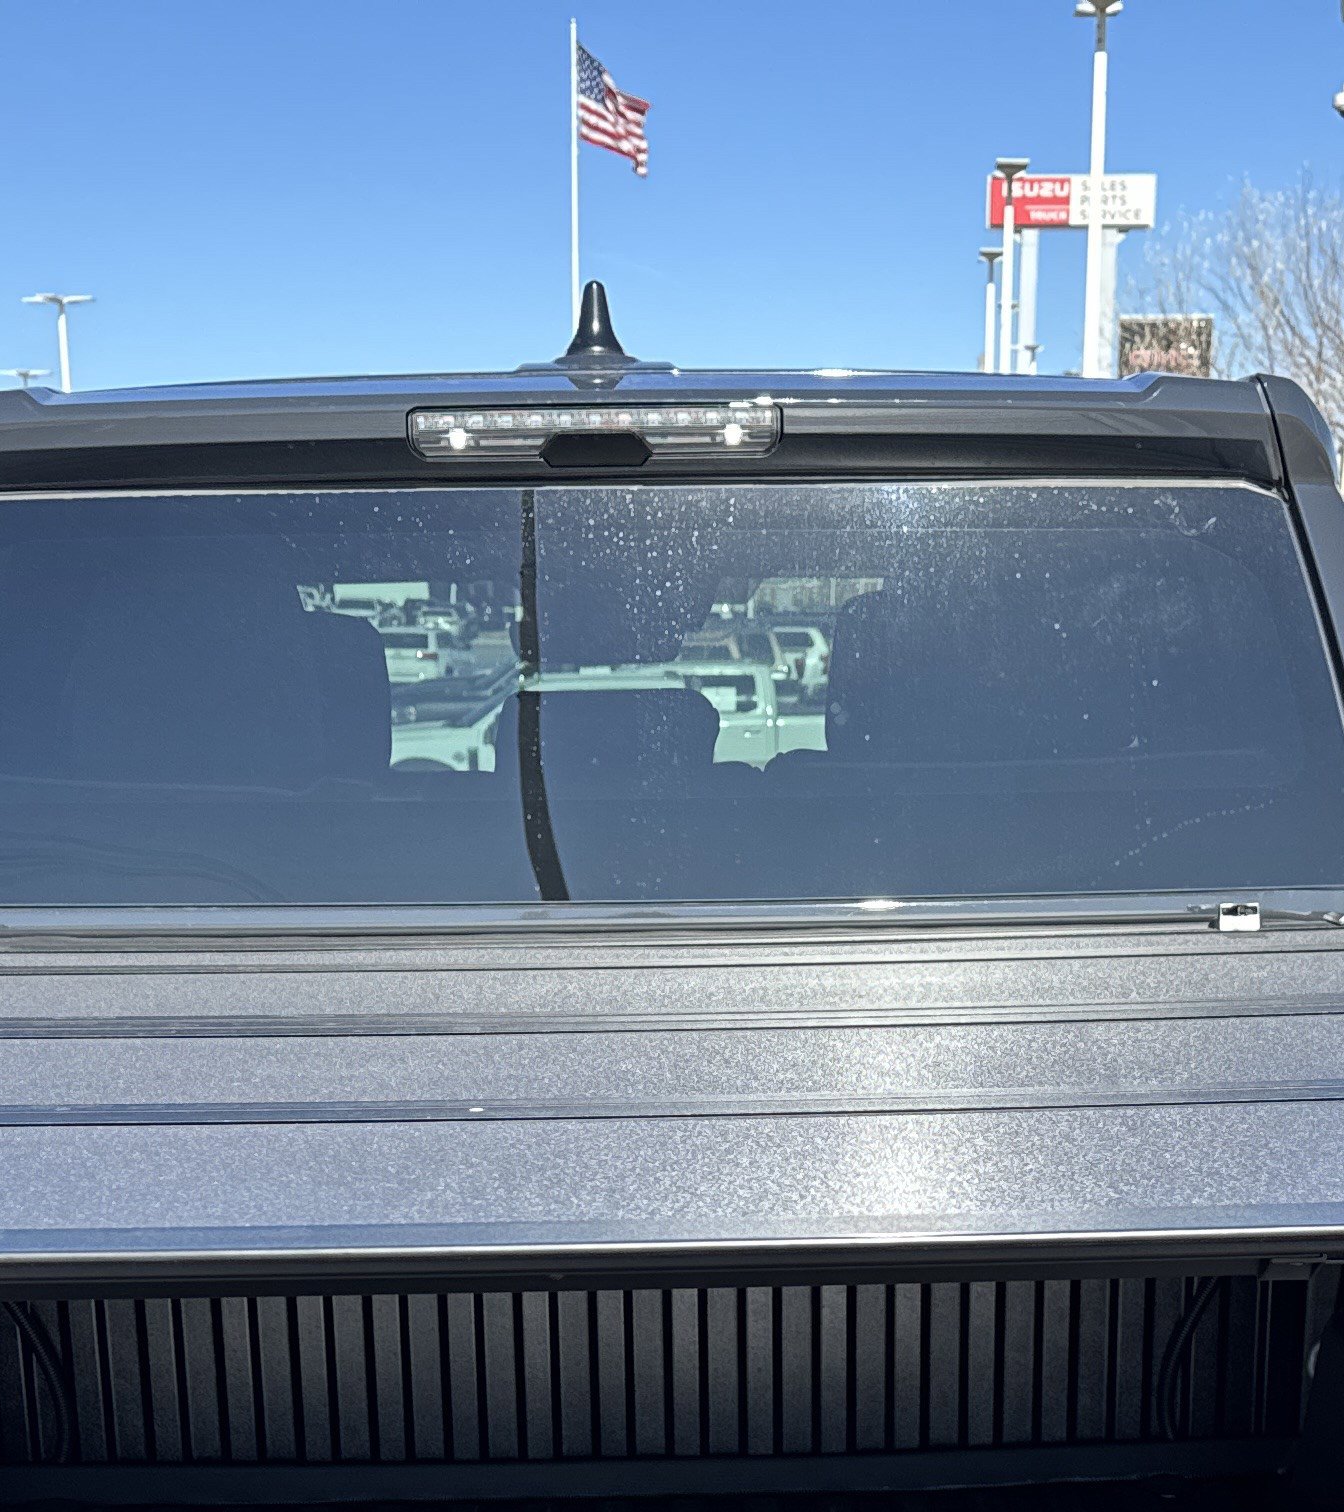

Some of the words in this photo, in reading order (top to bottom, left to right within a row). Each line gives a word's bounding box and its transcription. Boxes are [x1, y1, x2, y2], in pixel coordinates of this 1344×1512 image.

[1001, 180, 1069, 198] ISUZU
[1080, 180, 1127, 192] SLES
[1079, 209, 1142, 220] SRVICE
